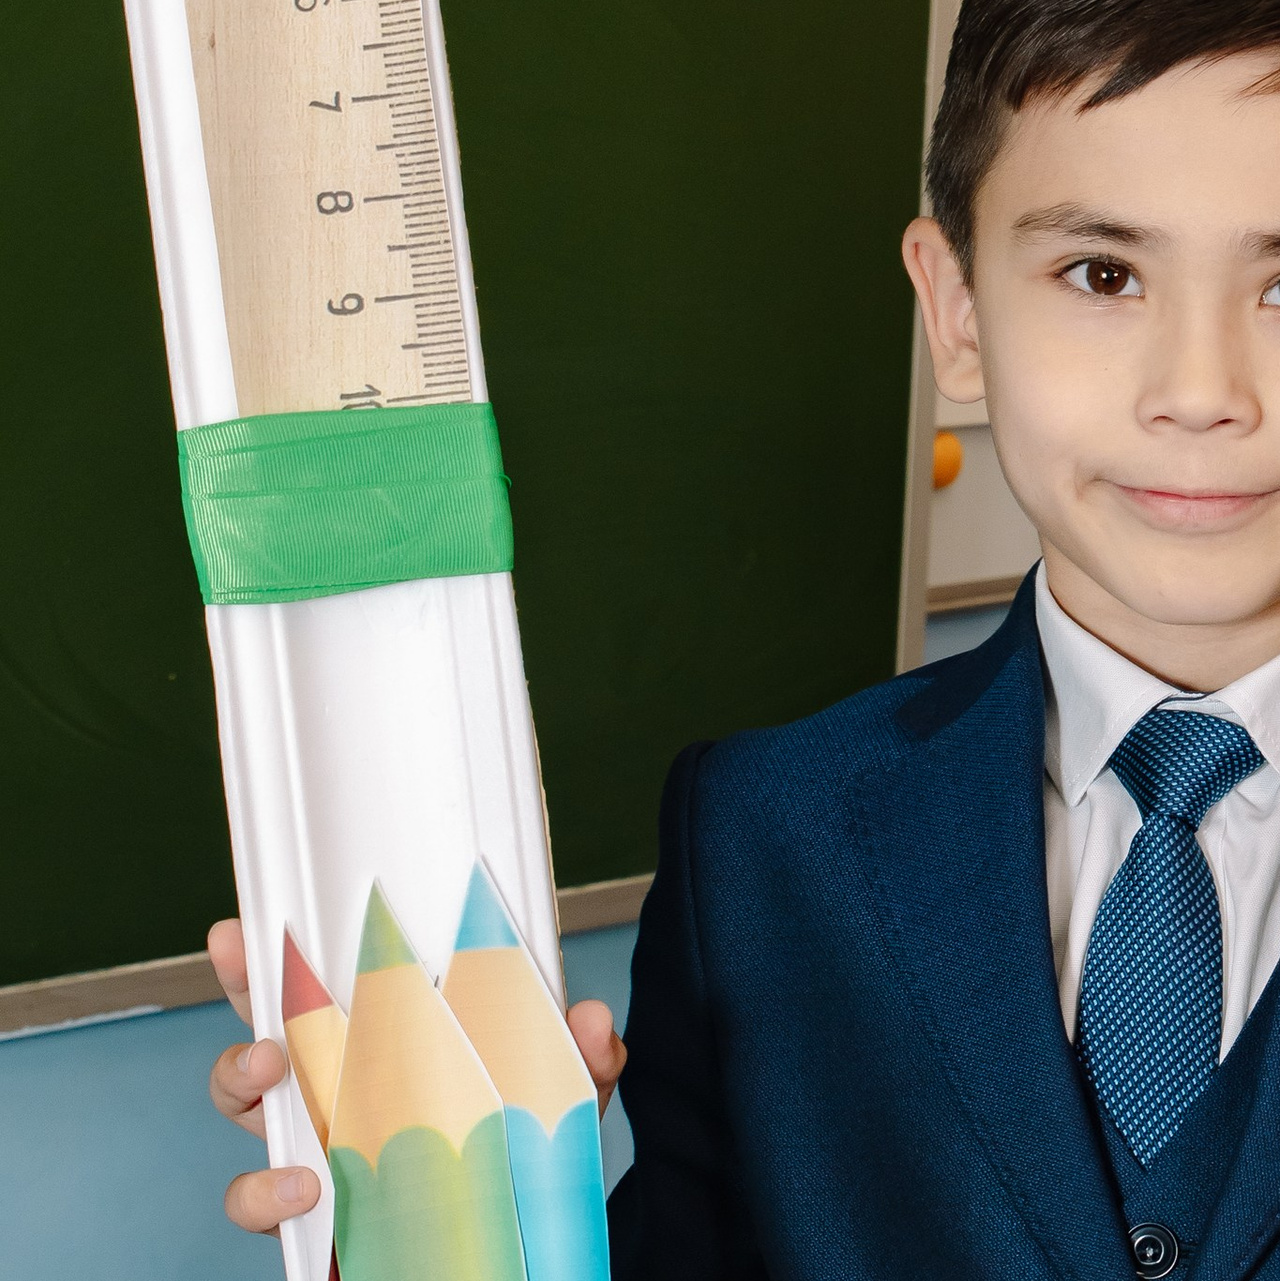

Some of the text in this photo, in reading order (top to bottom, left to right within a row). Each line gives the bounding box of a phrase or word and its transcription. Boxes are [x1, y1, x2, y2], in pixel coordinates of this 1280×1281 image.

[309, 91, 343, 112] 7
[316, 190, 353, 215] 8
[328, 293, 365, 316] 9
[340, 384, 382, 410] 1
